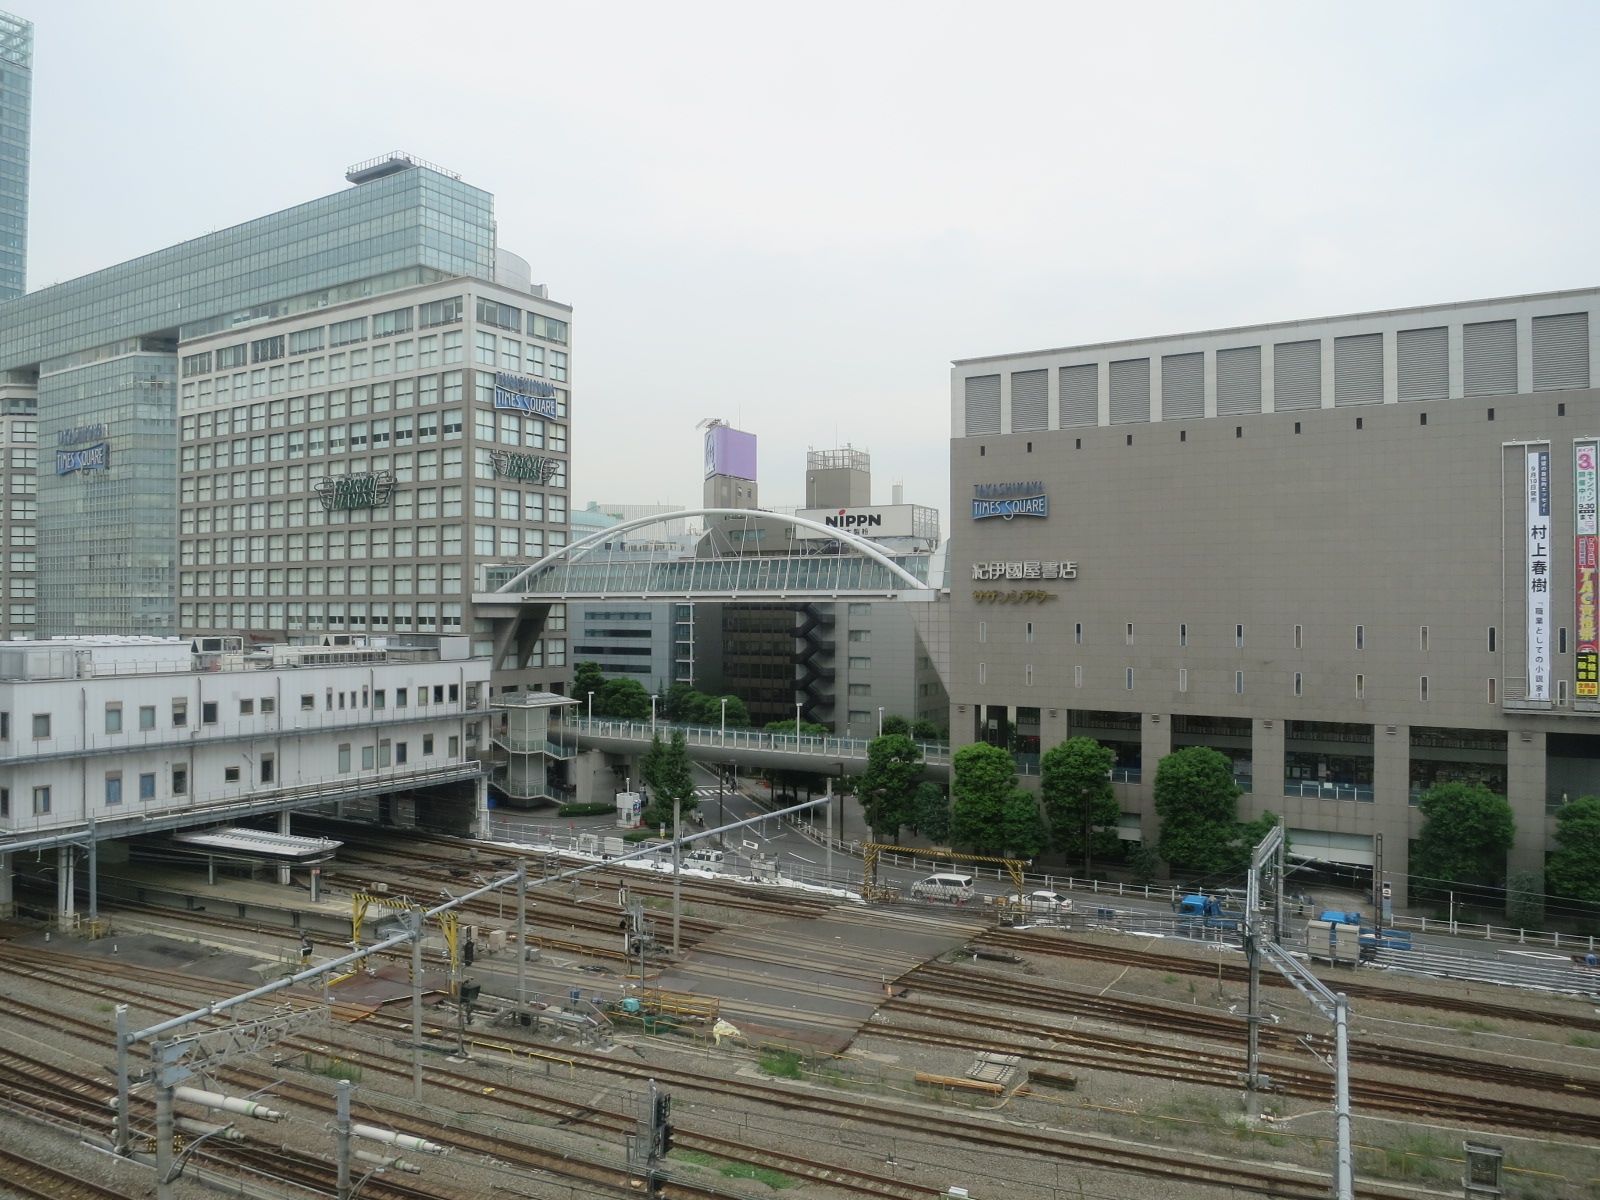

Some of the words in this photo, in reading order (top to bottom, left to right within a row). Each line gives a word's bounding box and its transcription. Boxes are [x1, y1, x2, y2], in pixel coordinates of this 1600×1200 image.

[496, 389, 520, 408] TIMES
[522, 395, 556, 417] SQUARE
[57, 452, 75, 470] TIMES
[78, 448, 103, 473] SQUARE
[973, 501, 1001, 515] TIMES
[1003, 498, 1045, 520] SQUARE
[972, 560, 1078, 580] 紀伊國屋書店
[1531, 524, 1547, 593] 村上春樹
